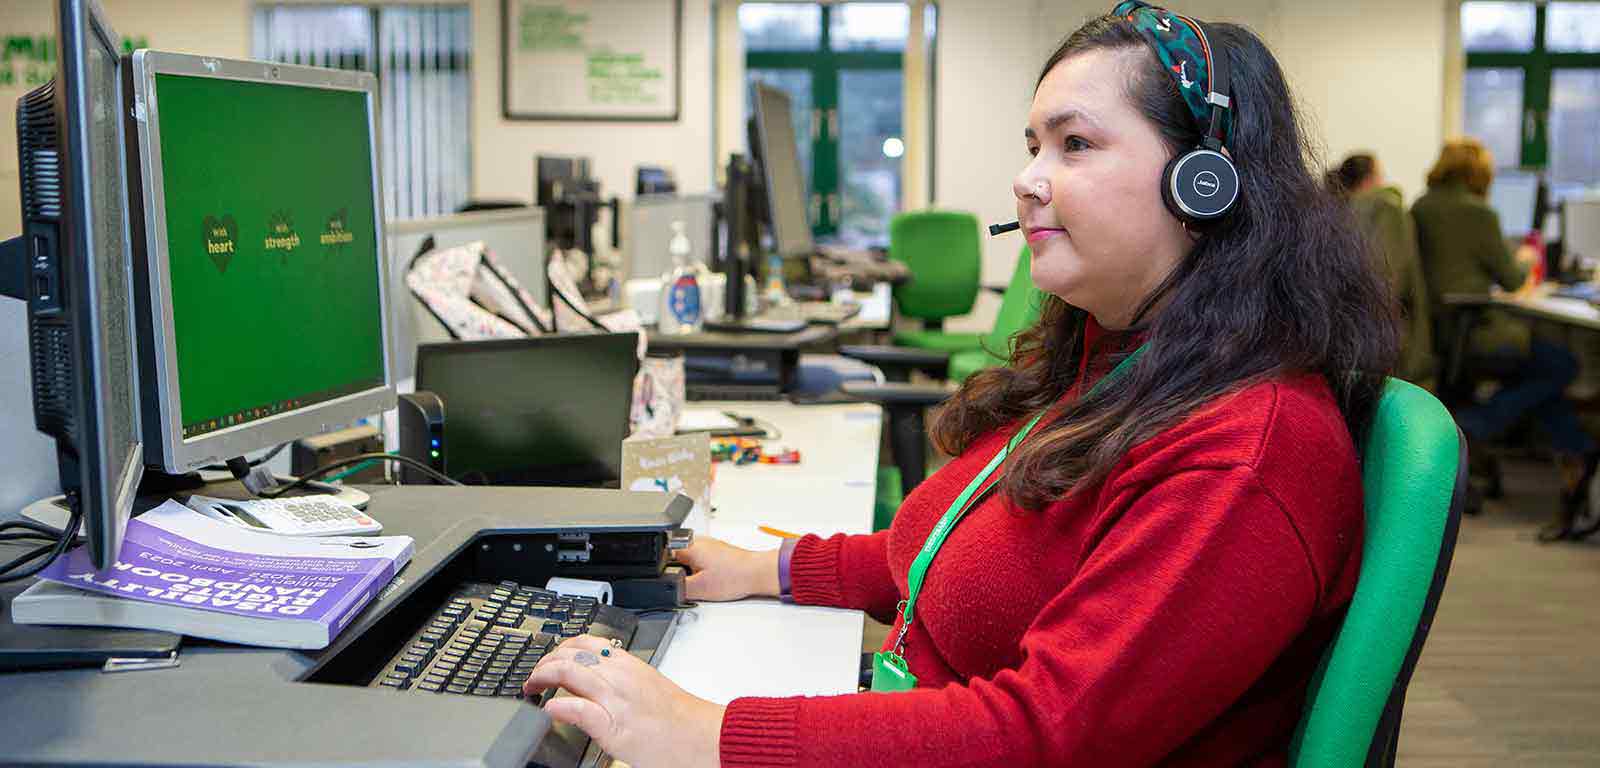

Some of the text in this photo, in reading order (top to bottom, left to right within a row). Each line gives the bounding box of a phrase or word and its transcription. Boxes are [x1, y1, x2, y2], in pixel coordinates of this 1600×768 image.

[208, 240, 235, 254] heart
[264, 233, 300, 250] strength
[138, 551, 185, 567] 2023
[190, 564, 235, 574] April
[113, 560, 329, 598] HANDBOOK
[299, 574, 345, 583] April
[67, 572, 310, 615] DISABILITY
[167, 583, 320, 607] RIGHTS
